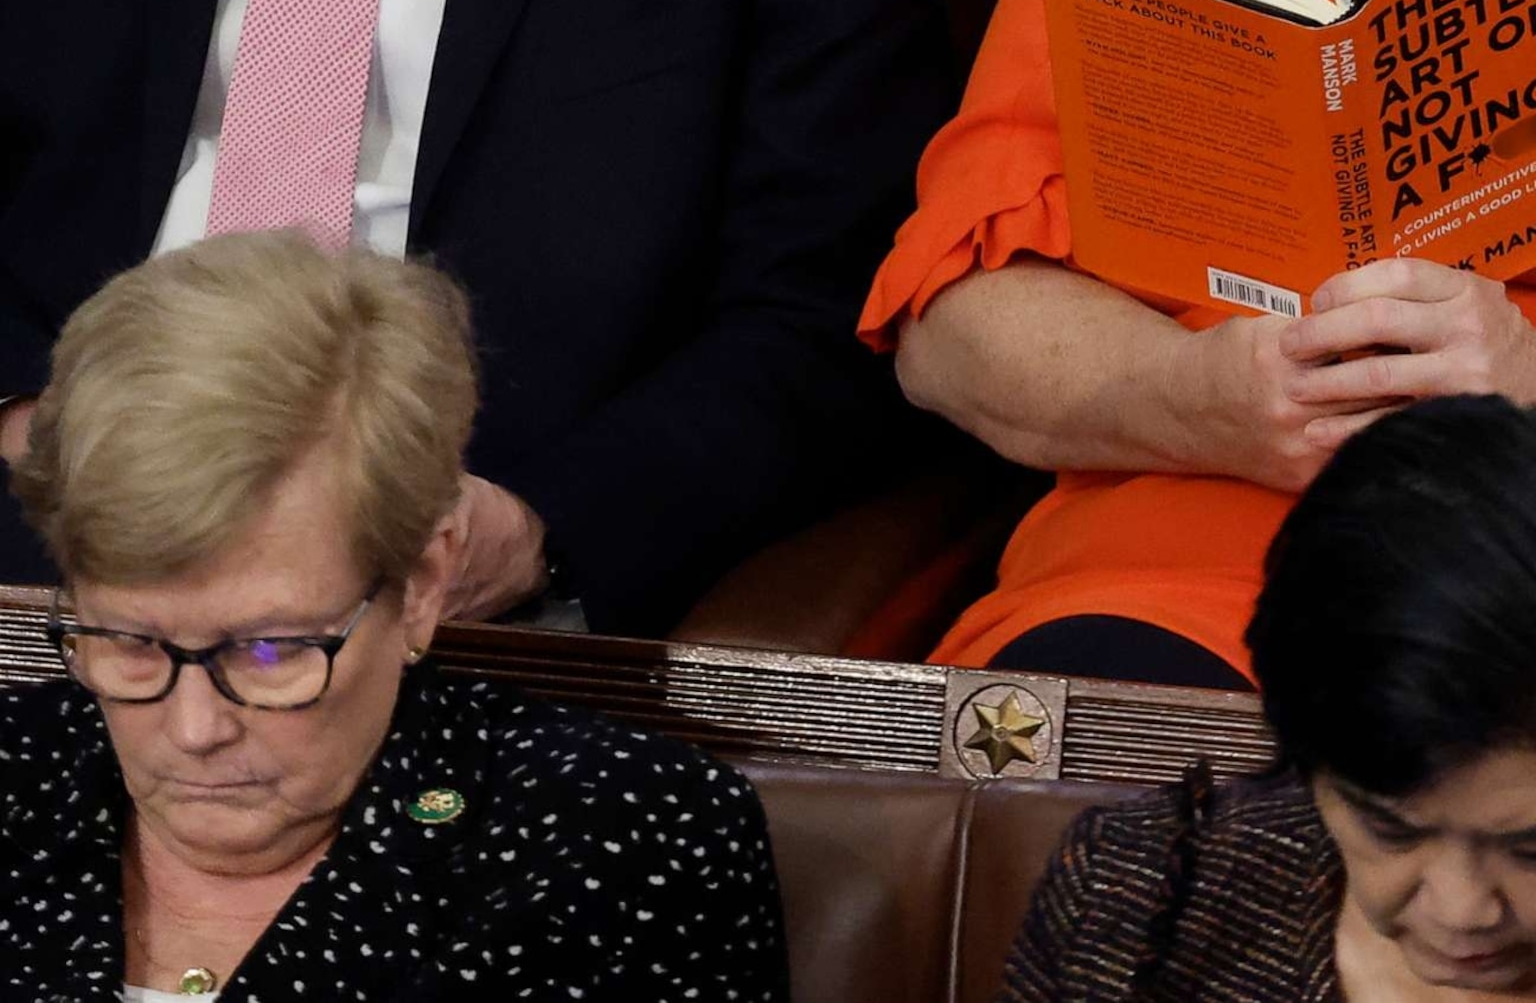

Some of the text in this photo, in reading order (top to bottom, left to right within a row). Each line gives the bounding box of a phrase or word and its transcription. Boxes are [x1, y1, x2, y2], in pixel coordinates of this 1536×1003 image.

[1129, 4, 1184, 29] ABOUT
[1190, 24, 1226, 44] THIS
[1231, 38, 1279, 60] BOOK
[1212, 19, 1250, 38] GIVE
[1255, 33, 1267, 44] A
[1320, 43, 1344, 112] MANSON
[1338, 38, 1358, 86] MARK
[1379, 39, 1470, 119] ART
[1382, 70, 1480, 152] NOT
[1331, 134, 1349, 164] NOT
[1349, 127, 1365, 161] THE
[1334, 169, 1355, 223] GIVING
[1353, 162, 1373, 221] SUBTLE
[1390, 181, 1424, 222] A
[1342, 226, 1357, 238] A
[1360, 224, 1377, 253] ART
[1393, 232, 1402, 245] A
[1415, 219, 1463, 248] LIVING
[1465, 211, 1477, 223] A
[1479, 189, 1522, 216] GOOD
